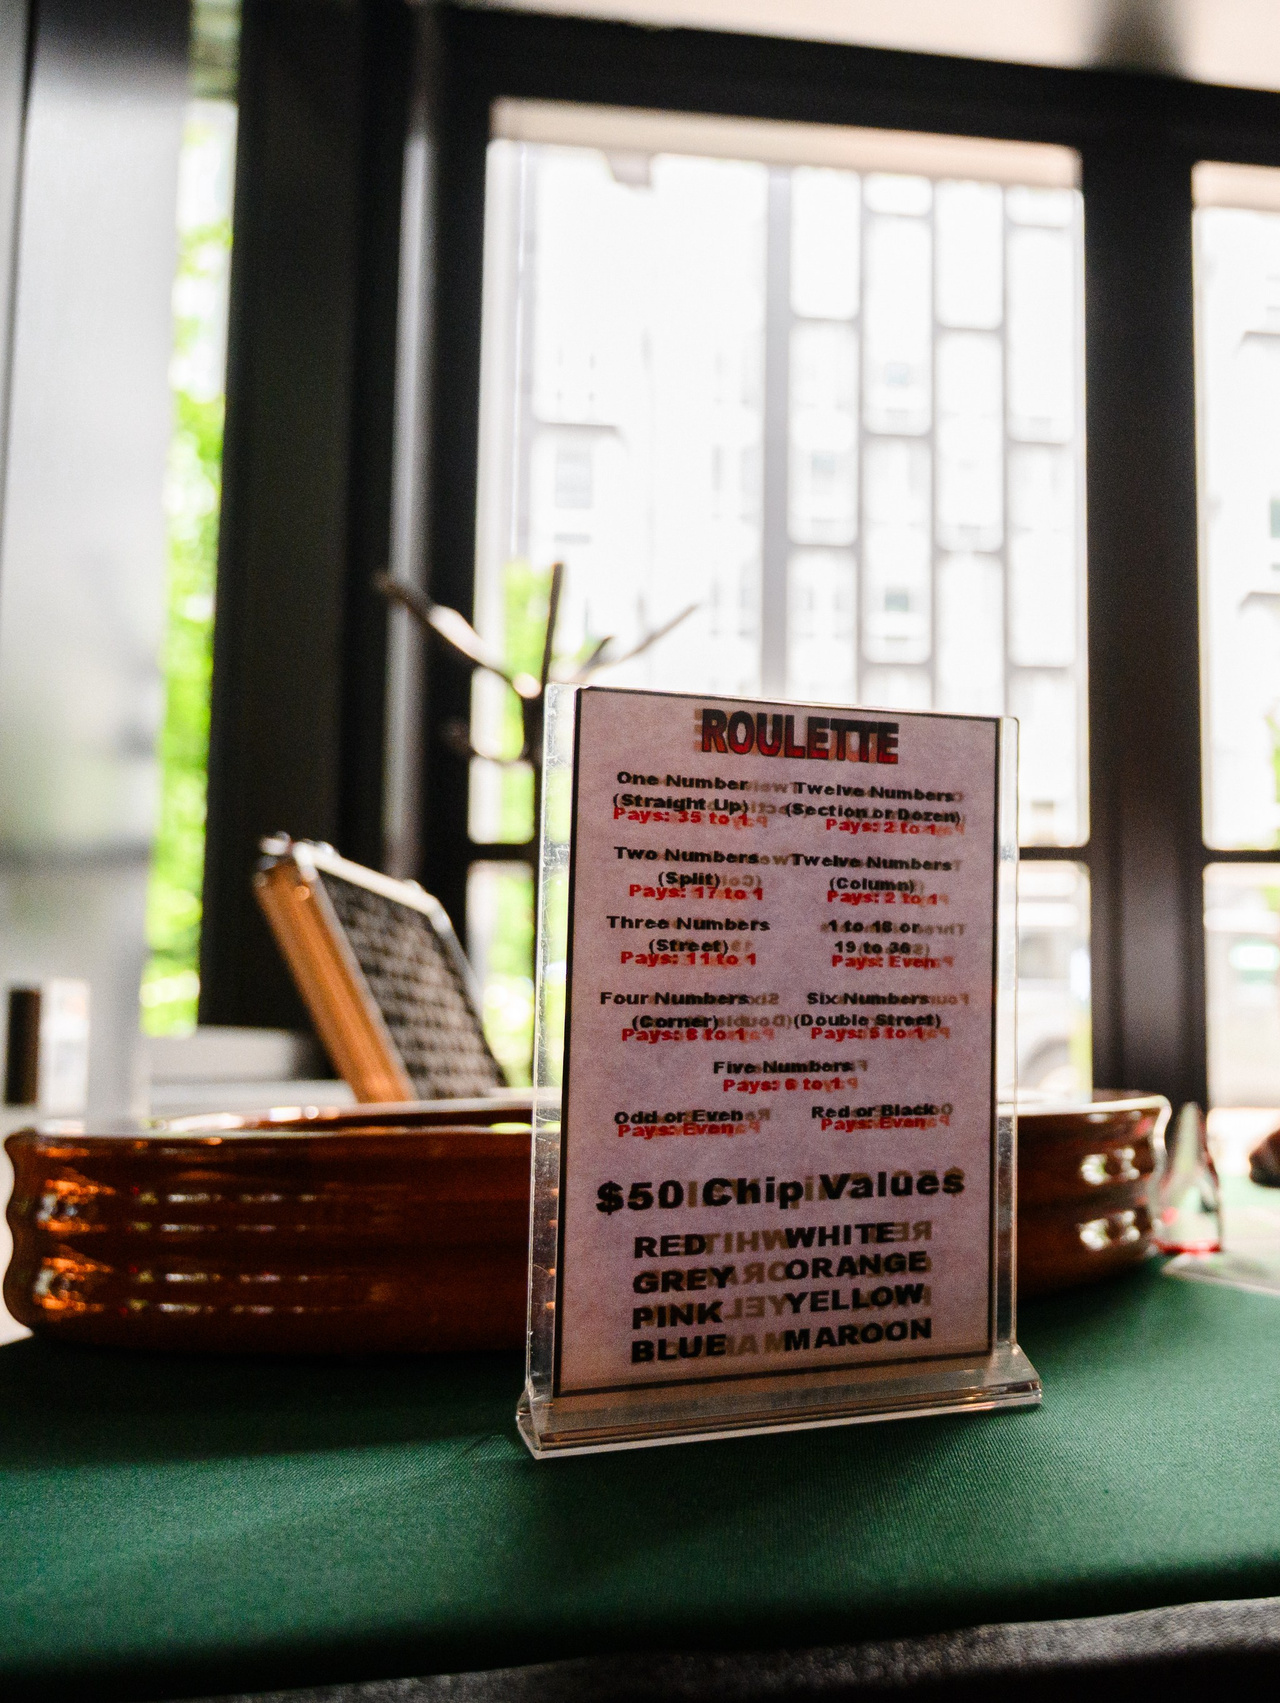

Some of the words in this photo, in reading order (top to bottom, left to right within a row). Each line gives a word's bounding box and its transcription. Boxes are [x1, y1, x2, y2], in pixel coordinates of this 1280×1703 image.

[701, 708, 899, 765] ROULETTE
[617, 771, 658, 785] One
[666, 774, 748, 790] Number
[794, 782, 865, 797] Twelve
[870, 786, 956, 803] Numbers
[613, 793, 706, 812] (Straight
[713, 798, 749, 815] Up)
[613, 807, 670, 824] Pays:
[678, 811, 702, 823] 35
[709, 812, 730, 825] to
[739, 813, 748, 825] 1
[785, 802, 868, 819] (Section
[873, 808, 891, 820] or
[898, 808, 961, 825] Dozen)
[826, 819, 878, 835] Pays:
[883, 821, 895, 833] 2
[900, 821, 920, 834] to
[926, 823, 936, 835] 1
[614, 846, 658, 861] Two
[664, 848, 759, 864] Numbers
[791, 853, 861, 867] Twelve
[867, 856, 953, 871] Numbers
[658, 871, 720, 888] (Split)
[829, 877, 915, 893] (Column)
[629, 884, 687, 900] Pays:
[693, 887, 716, 899] 17
[724, 887, 746, 900] to
[752, 888, 763, 900] 1
[827, 890, 879, 906] Pays:
[883, 891, 895, 904] 2
[903, 892, 921, 905] to
[929, 894, 938, 905] 1
[606, 916, 669, 929] Three
[676, 917, 770, 931] Numbers
[828, 919, 838, 932] 1
[843, 920, 864, 933] to
[872, 921, 893, 933] 18
[899, 922, 921, 933] or
[649, 939, 729, 955] (Street)
[834, 940, 856, 953] 19
[863, 941, 883, 954] to
[889, 942, 911, 954] 36
[621, 951, 678, 967] Pays:
[686, 952, 710, 965] 11
[716, 953, 739, 966] to
[747, 953, 756, 965] 1
[832, 955, 883, 970] Pays:
[888, 956, 938, 969] Even
[600, 992, 649, 1005] Four
[654, 992, 751, 1005] Numbers
[807, 992, 837, 1005] Six
[843, 992, 930, 1005] Numbers
[632, 1015, 719, 1032] (Corner)
[793, 1013, 869, 1029] (Double
[875, 1013, 942, 1029] Street)
[621, 1028, 680, 1044] Pays:
[703, 1028, 727, 1041] to
[735, 1028, 745, 1041] 1
[811, 1027, 864, 1042] Pays:
[885, 1028, 907, 1040] to
[915, 1027, 924, 1040] 1
[713, 1061, 757, 1074] Five
[763, 1060, 853, 1074] Numbers
[723, 1079, 780, 1094] Pays:
[803, 1077, 823, 1090] to
[831, 1077, 841, 1090] 1
[614, 1110, 658, 1125] Odd
[664, 1111, 686, 1123] or
[692, 1109, 744, 1123] Even
[811, 1106, 850, 1119] Red
[856, 1106, 876, 1118] or
[881, 1103, 936, 1117] Black
[618, 1124, 676, 1139] Pays:
[683, 1122, 735, 1137] Even
[821, 1118, 872, 1133] Pays:
[880, 1116, 926, 1130] Even
[596, 1180, 685, 1216] $50
[702, 1176, 803, 1210] Chip
[819, 1171, 965, 1201] Values
[785, 1222, 895, 1249] WHITE
[634, 1234, 707, 1259] RED
[784, 1251, 927, 1280] ORANGE
[633, 1265, 735, 1294] GREY
[785, 1283, 925, 1314] YELLOW
[632, 1301, 724, 1330] PINK
[784, 1317, 932, 1351] MAROON
[631, 1334, 727, 1363] BLUE
